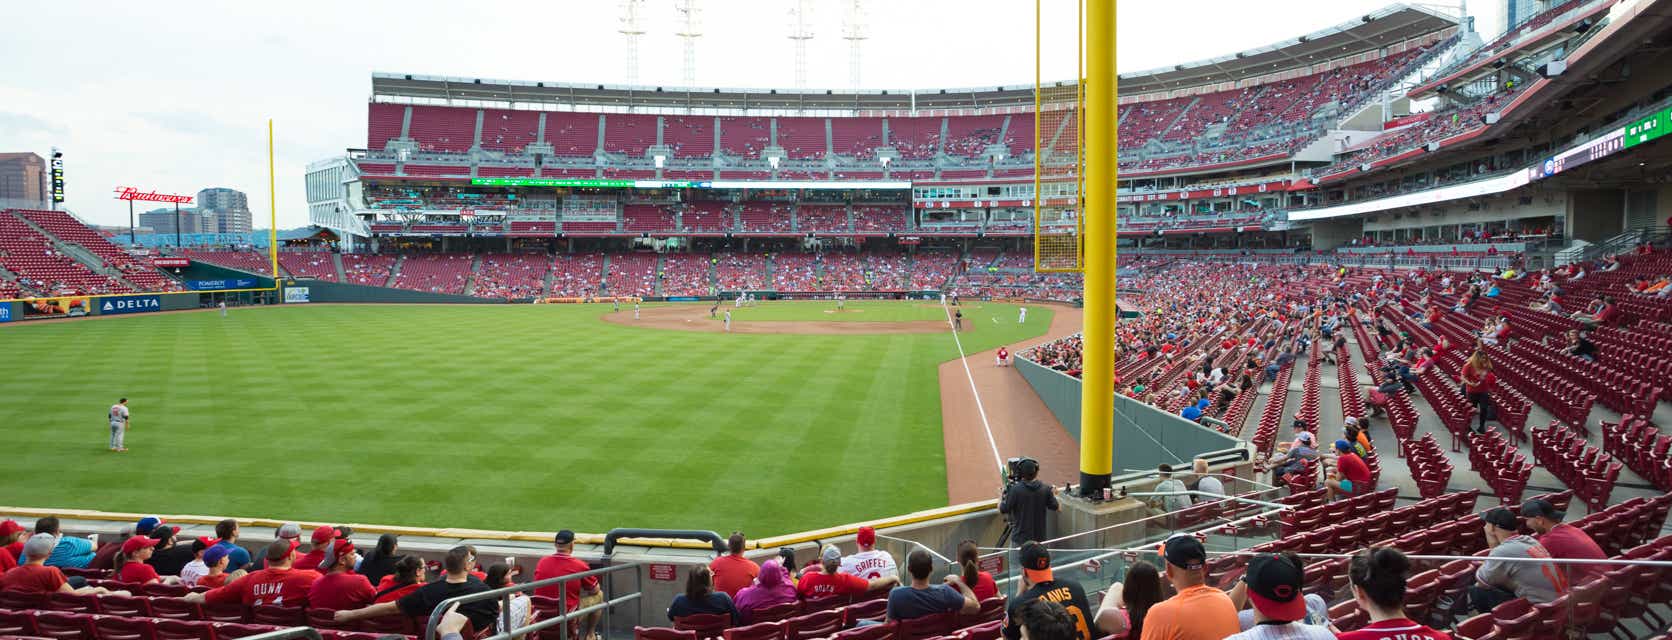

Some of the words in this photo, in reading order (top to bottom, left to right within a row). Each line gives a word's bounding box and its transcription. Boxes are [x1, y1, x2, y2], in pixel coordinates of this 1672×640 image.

[116, 186, 193, 203] Budweiser
[117, 299, 159, 309] DELTA
[253, 582, 284, 596] DUNN
